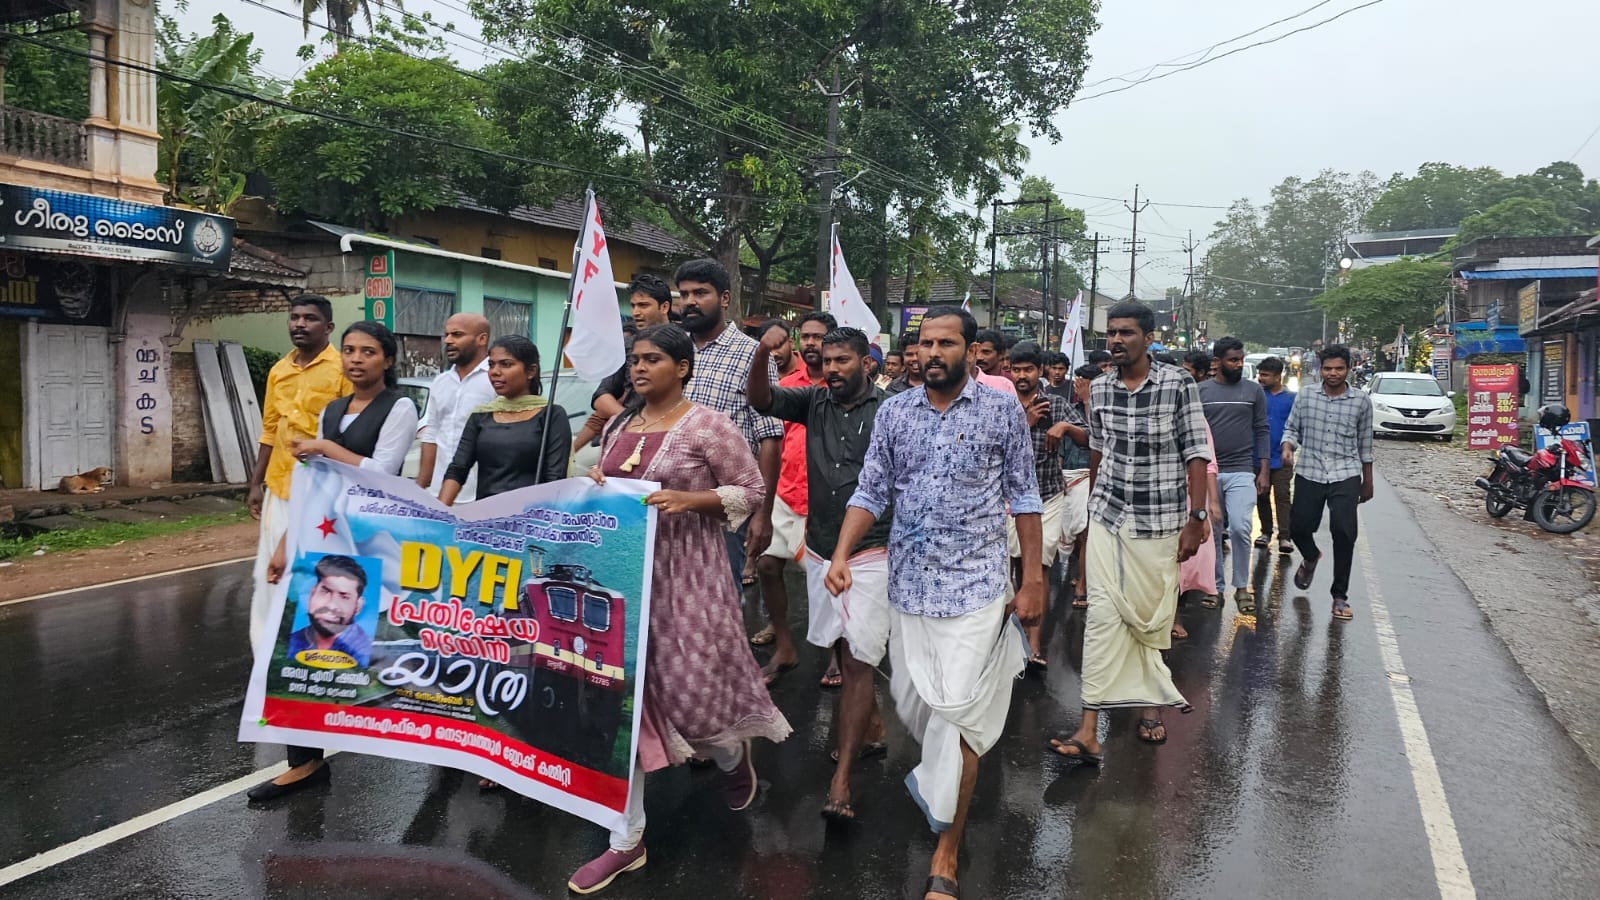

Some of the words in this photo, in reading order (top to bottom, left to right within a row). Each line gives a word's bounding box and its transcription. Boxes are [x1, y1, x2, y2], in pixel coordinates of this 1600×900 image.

[94, 218, 185, 245] ടൈംസ്
[400, 541, 523, 611] DYFI
[389, 596, 540, 642] പ്രതിഷേധ
[420, 629, 510, 664] ട്രെയിൻ
[378, 652, 528, 716] യാത്ര
